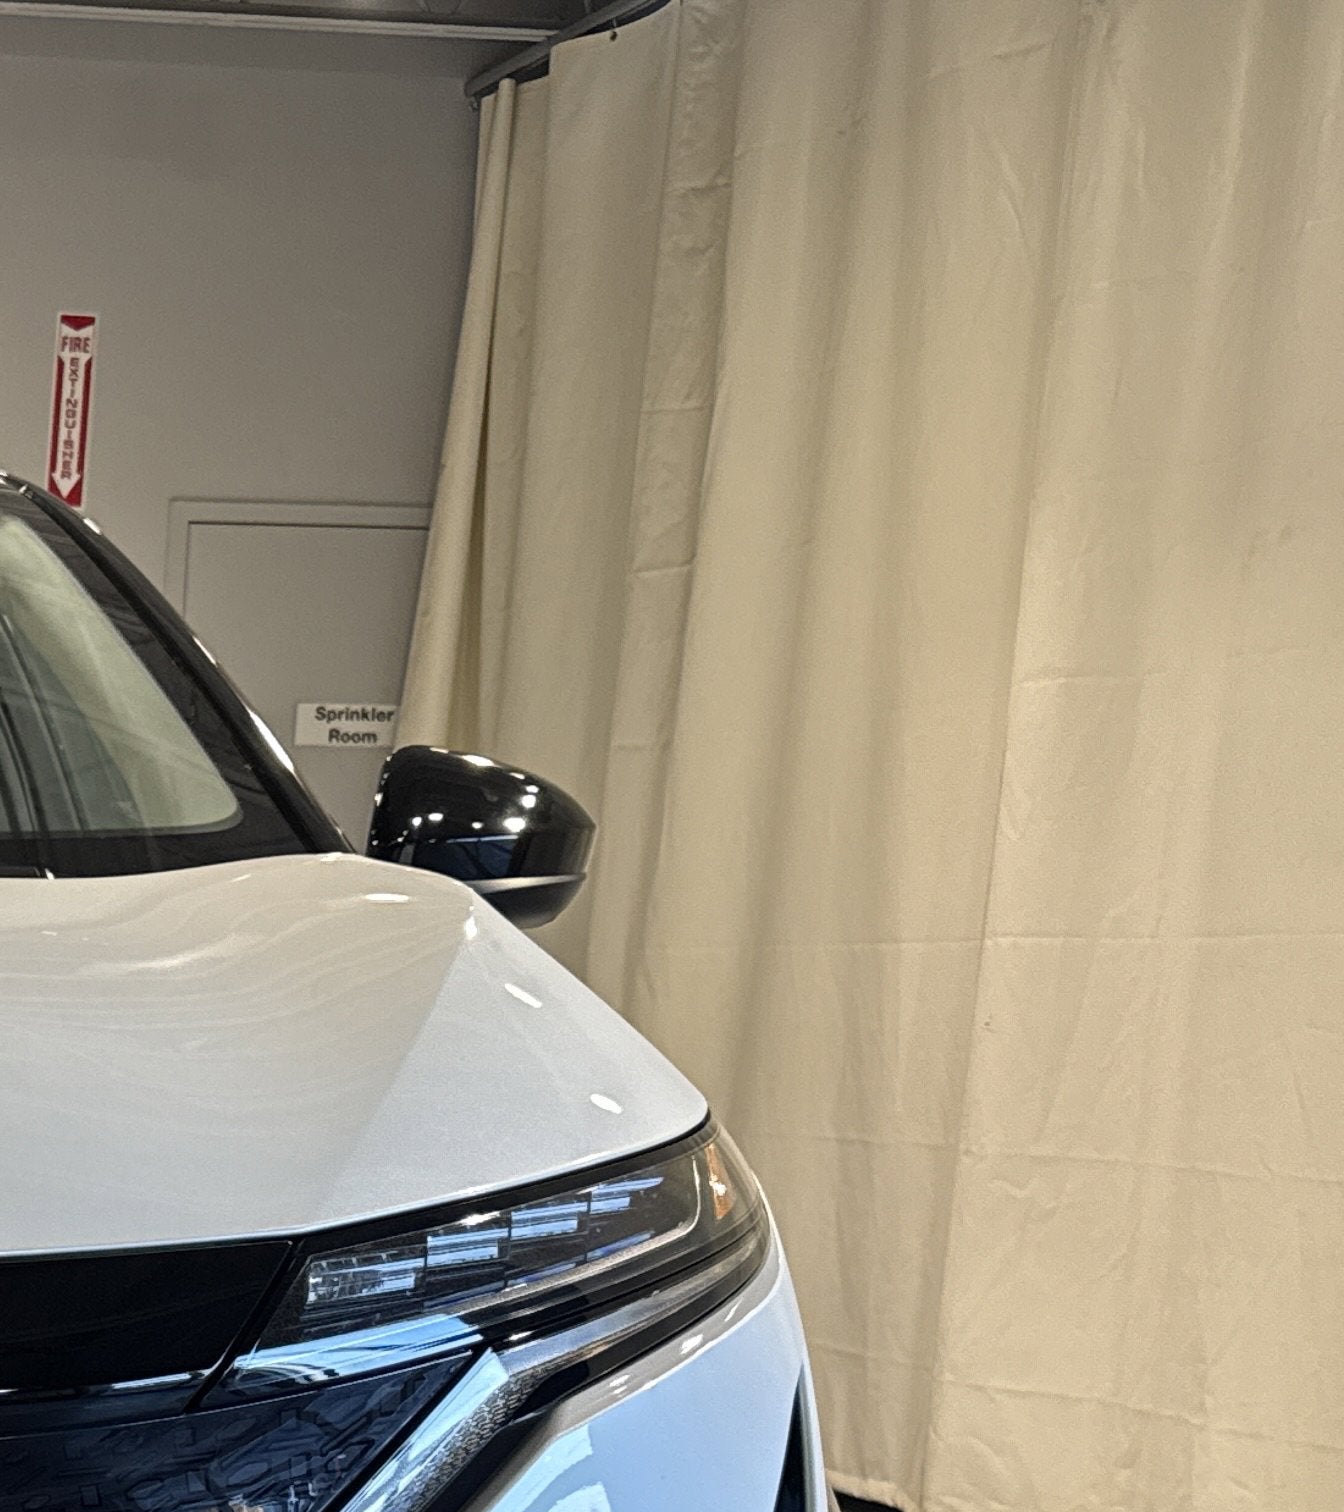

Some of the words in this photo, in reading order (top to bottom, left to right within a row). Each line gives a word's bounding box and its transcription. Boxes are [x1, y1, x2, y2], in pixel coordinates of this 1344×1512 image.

[60, 335, 91, 354] FIRE
[60, 357, 80, 480] EXTINGUISHER
[314, 706, 395, 723] Sprinkler
[327, 728, 378, 744] Room
